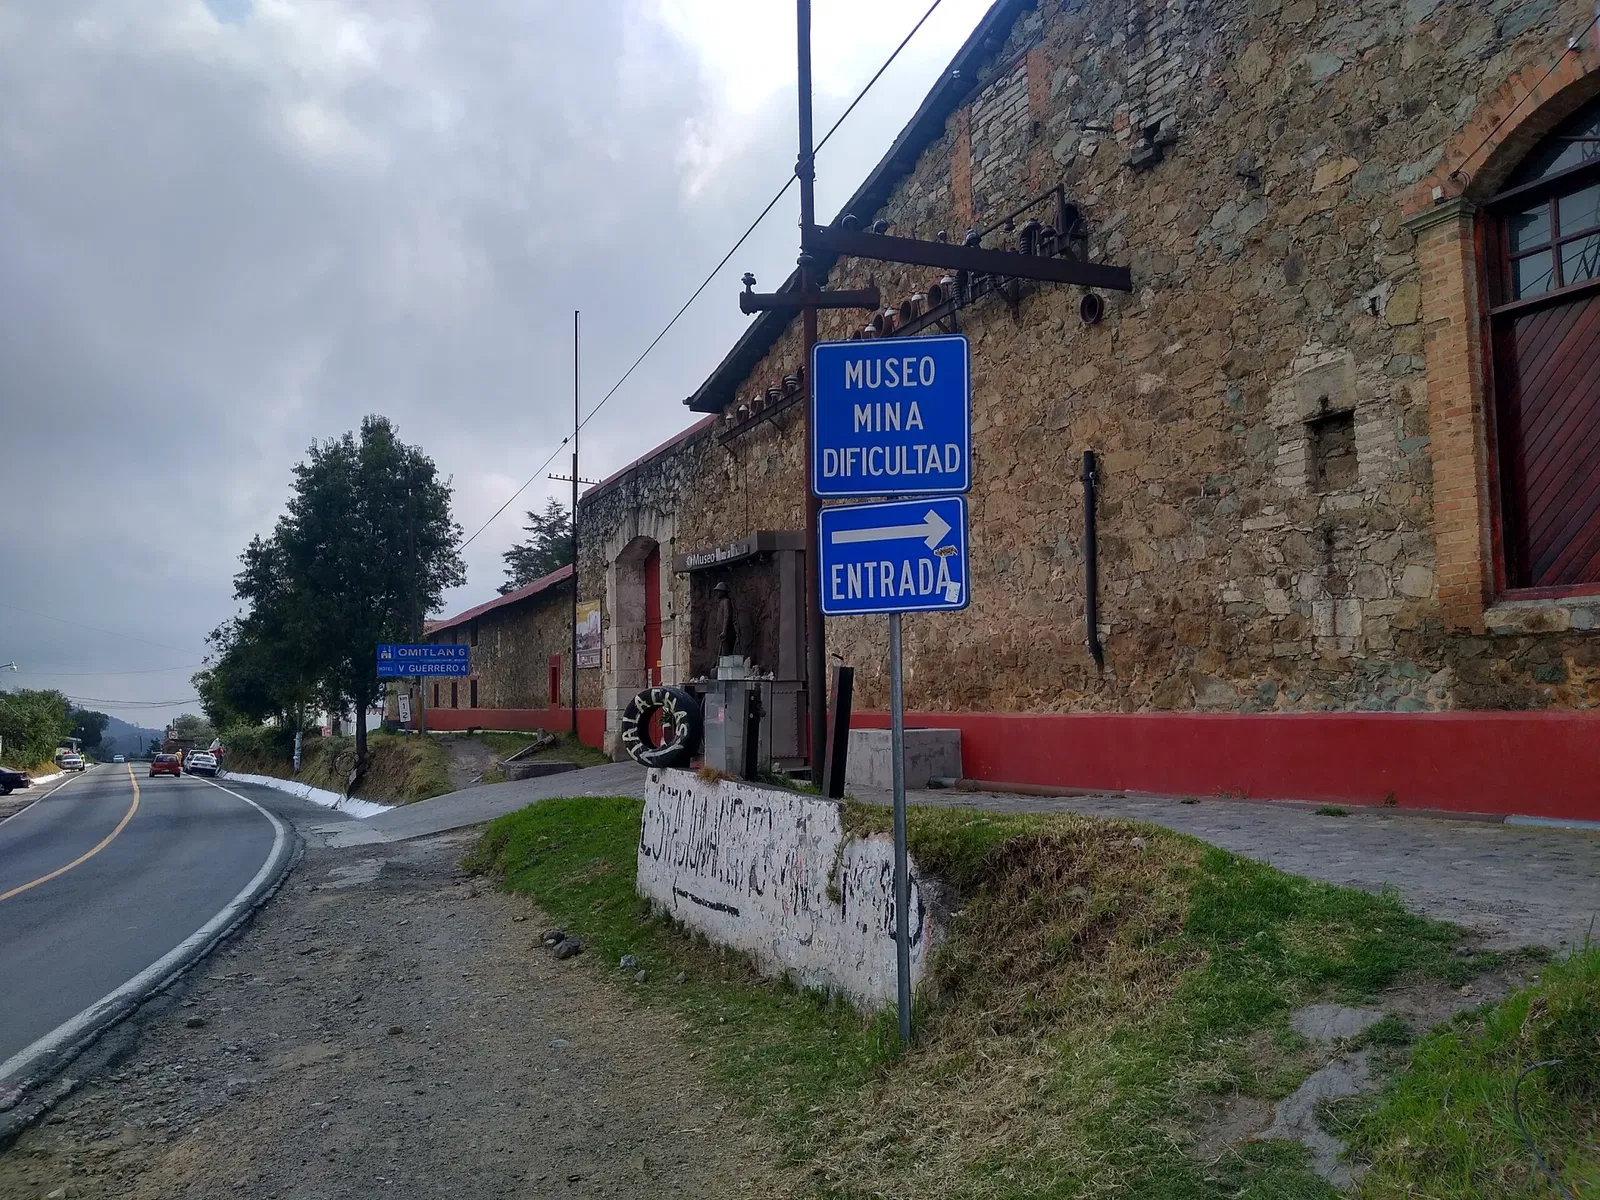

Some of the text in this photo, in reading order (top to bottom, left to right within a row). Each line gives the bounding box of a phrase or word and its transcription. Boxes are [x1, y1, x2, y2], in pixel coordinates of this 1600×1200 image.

[845, 355, 936, 389] MUSEO
[853, 401, 924, 433] MINA
[823, 443, 961, 478] DIFICULTAD
[693, 552, 715, 566] Museo
[831, 556, 951, 601] ENTRADA
[398, 648, 465, 657] OMITLAN 6
[398, 664, 466, 673] V GUERRERO 4
